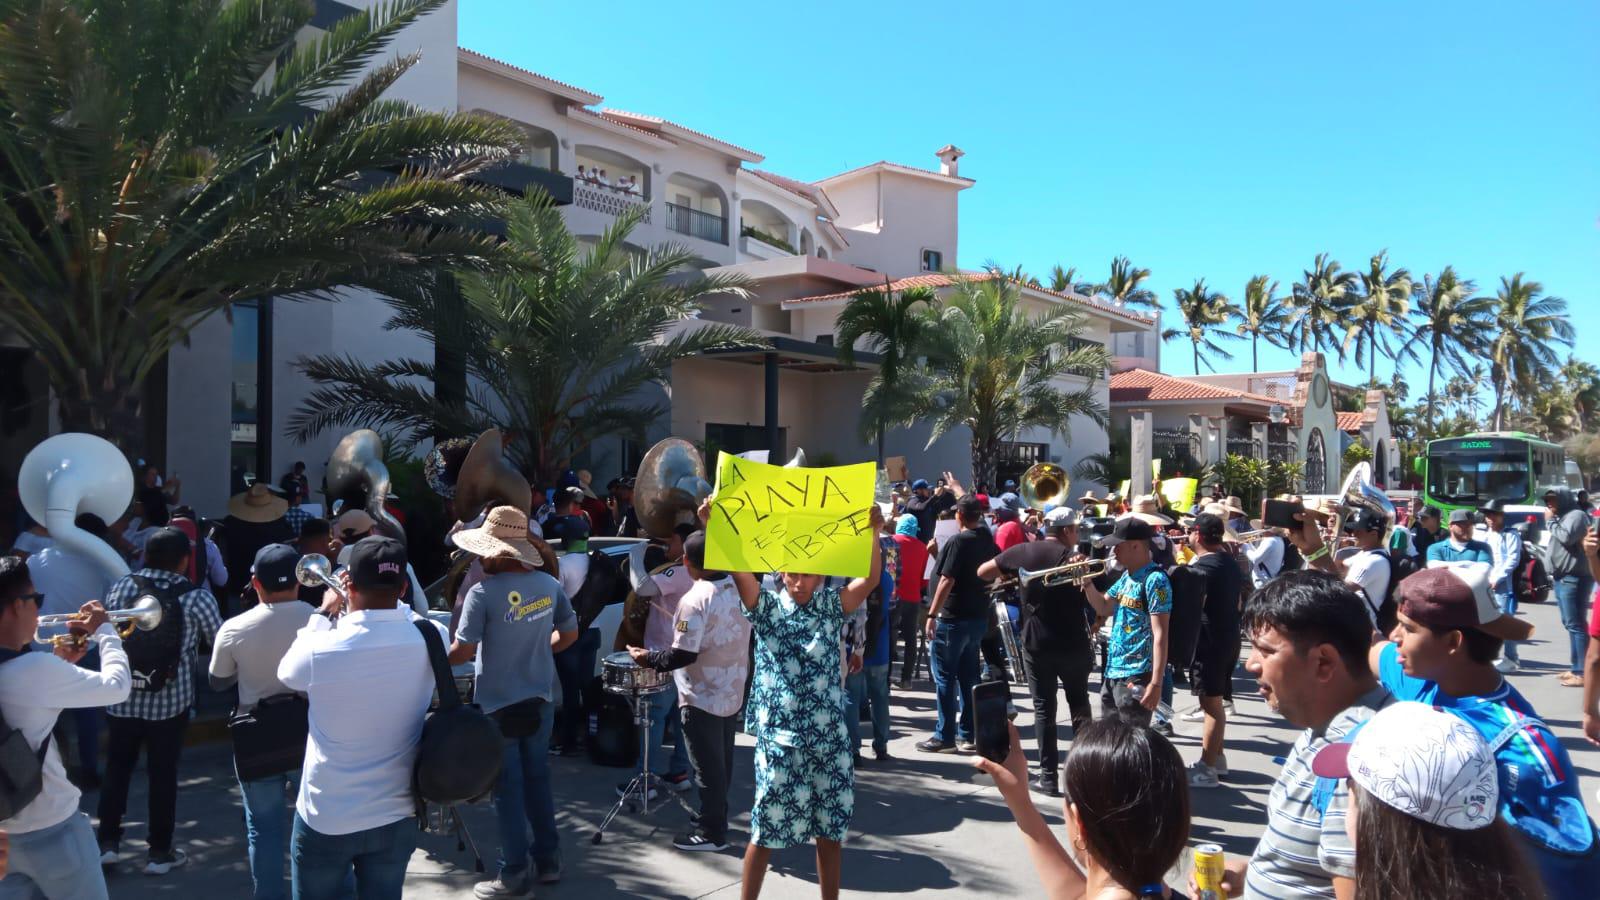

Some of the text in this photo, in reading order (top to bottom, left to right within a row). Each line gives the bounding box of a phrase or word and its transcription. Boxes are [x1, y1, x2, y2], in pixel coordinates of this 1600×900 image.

[718, 463, 746, 490] LA
[713, 475, 850, 535] PLAYA
[751, 523, 788, 550] ES
[760, 507, 872, 572] LIBRE
